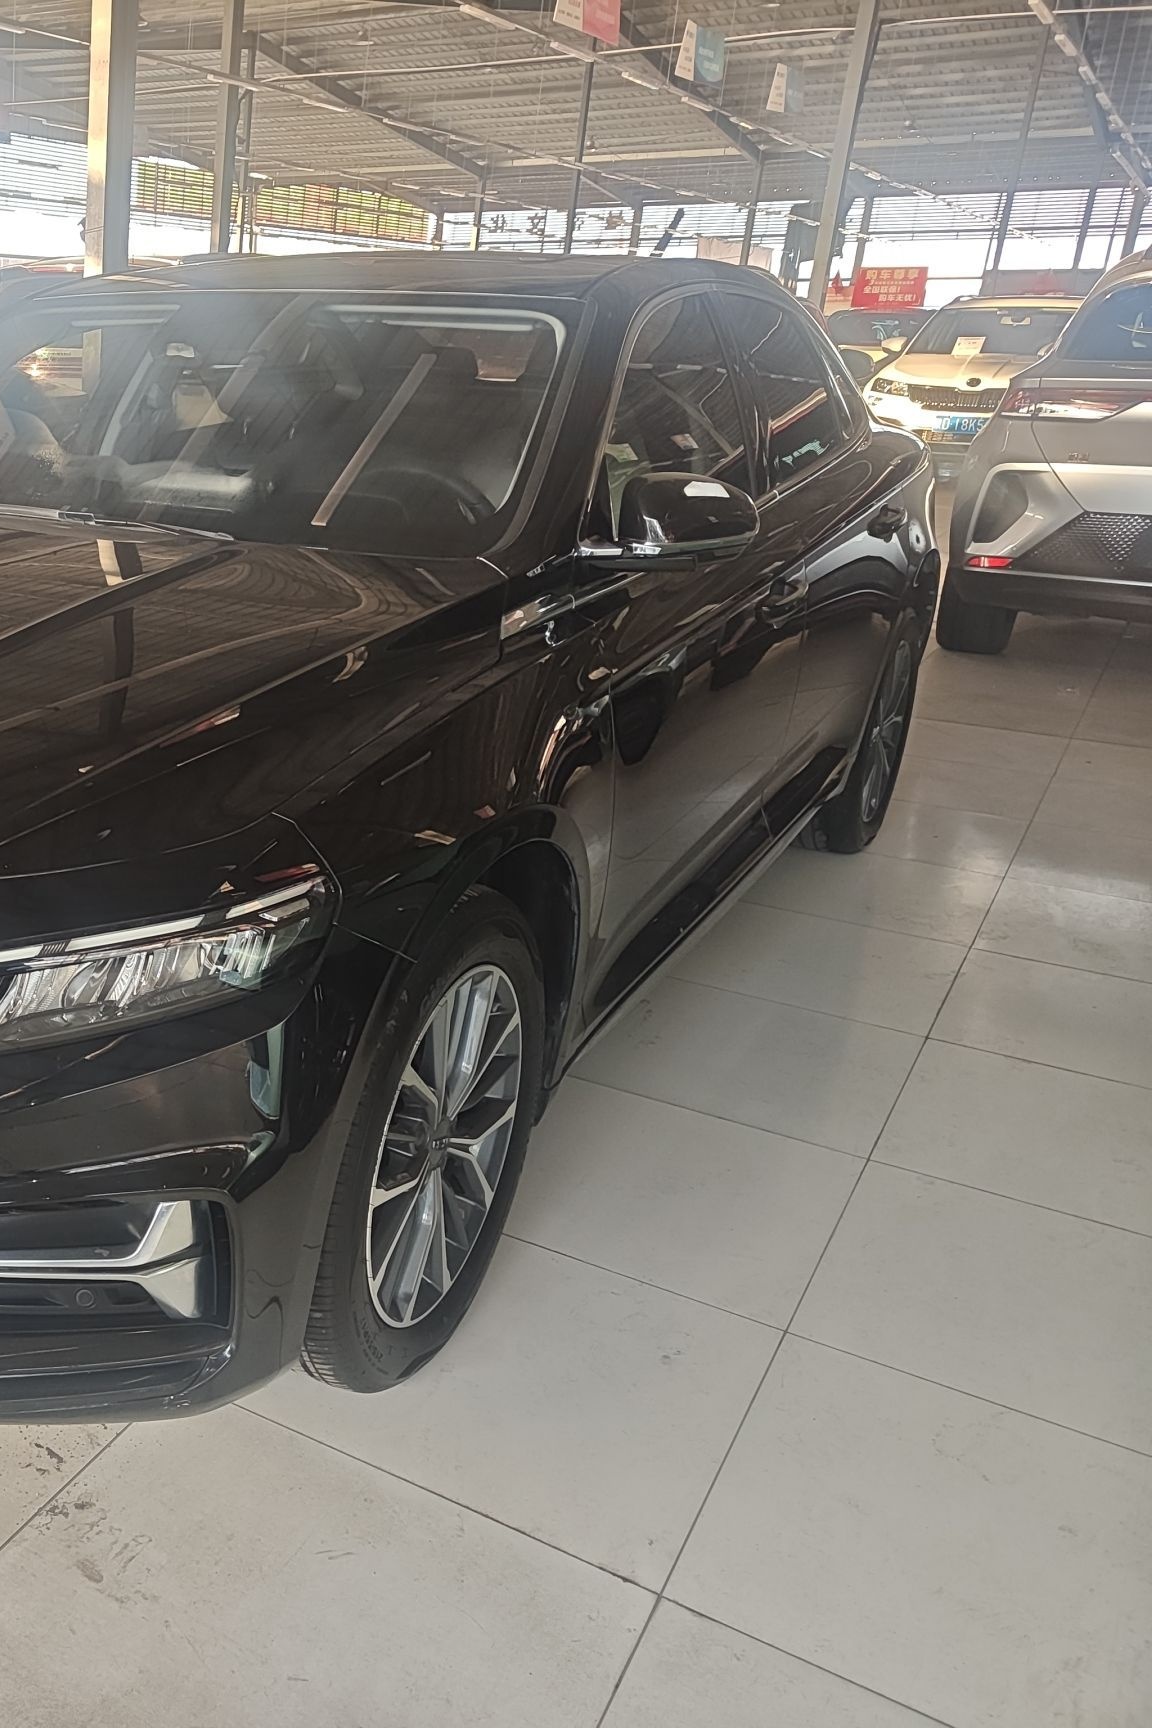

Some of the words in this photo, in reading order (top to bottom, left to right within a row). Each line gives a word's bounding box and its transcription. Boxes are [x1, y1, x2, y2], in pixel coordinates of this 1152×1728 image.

[865, 269, 920, 280] 购车尊享
[878, 294, 916, 302] 购车无忧!
